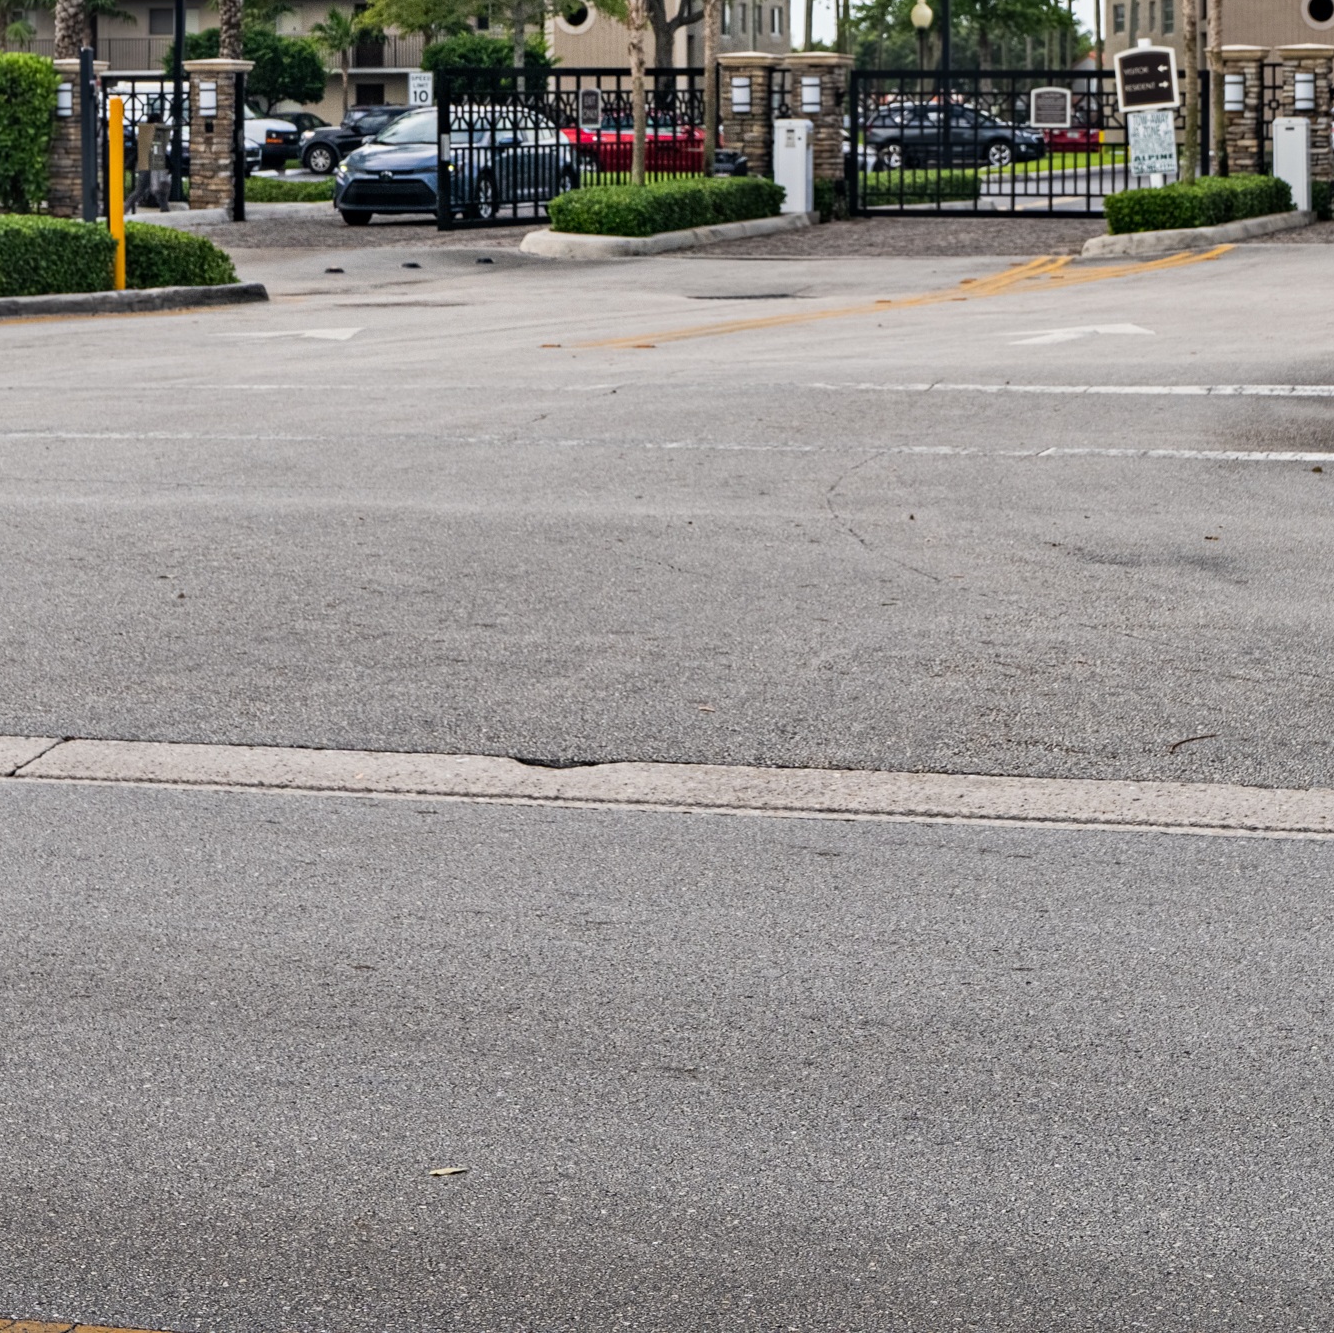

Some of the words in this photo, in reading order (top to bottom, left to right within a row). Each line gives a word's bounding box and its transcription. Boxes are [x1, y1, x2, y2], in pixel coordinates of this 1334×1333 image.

[1123, 66, 1149, 76] VISITOR
[1124, 81, 1156, 92] RESIDENT
[413, 90, 429, 103] 10
[1134, 153, 1173, 162] ALPINE
